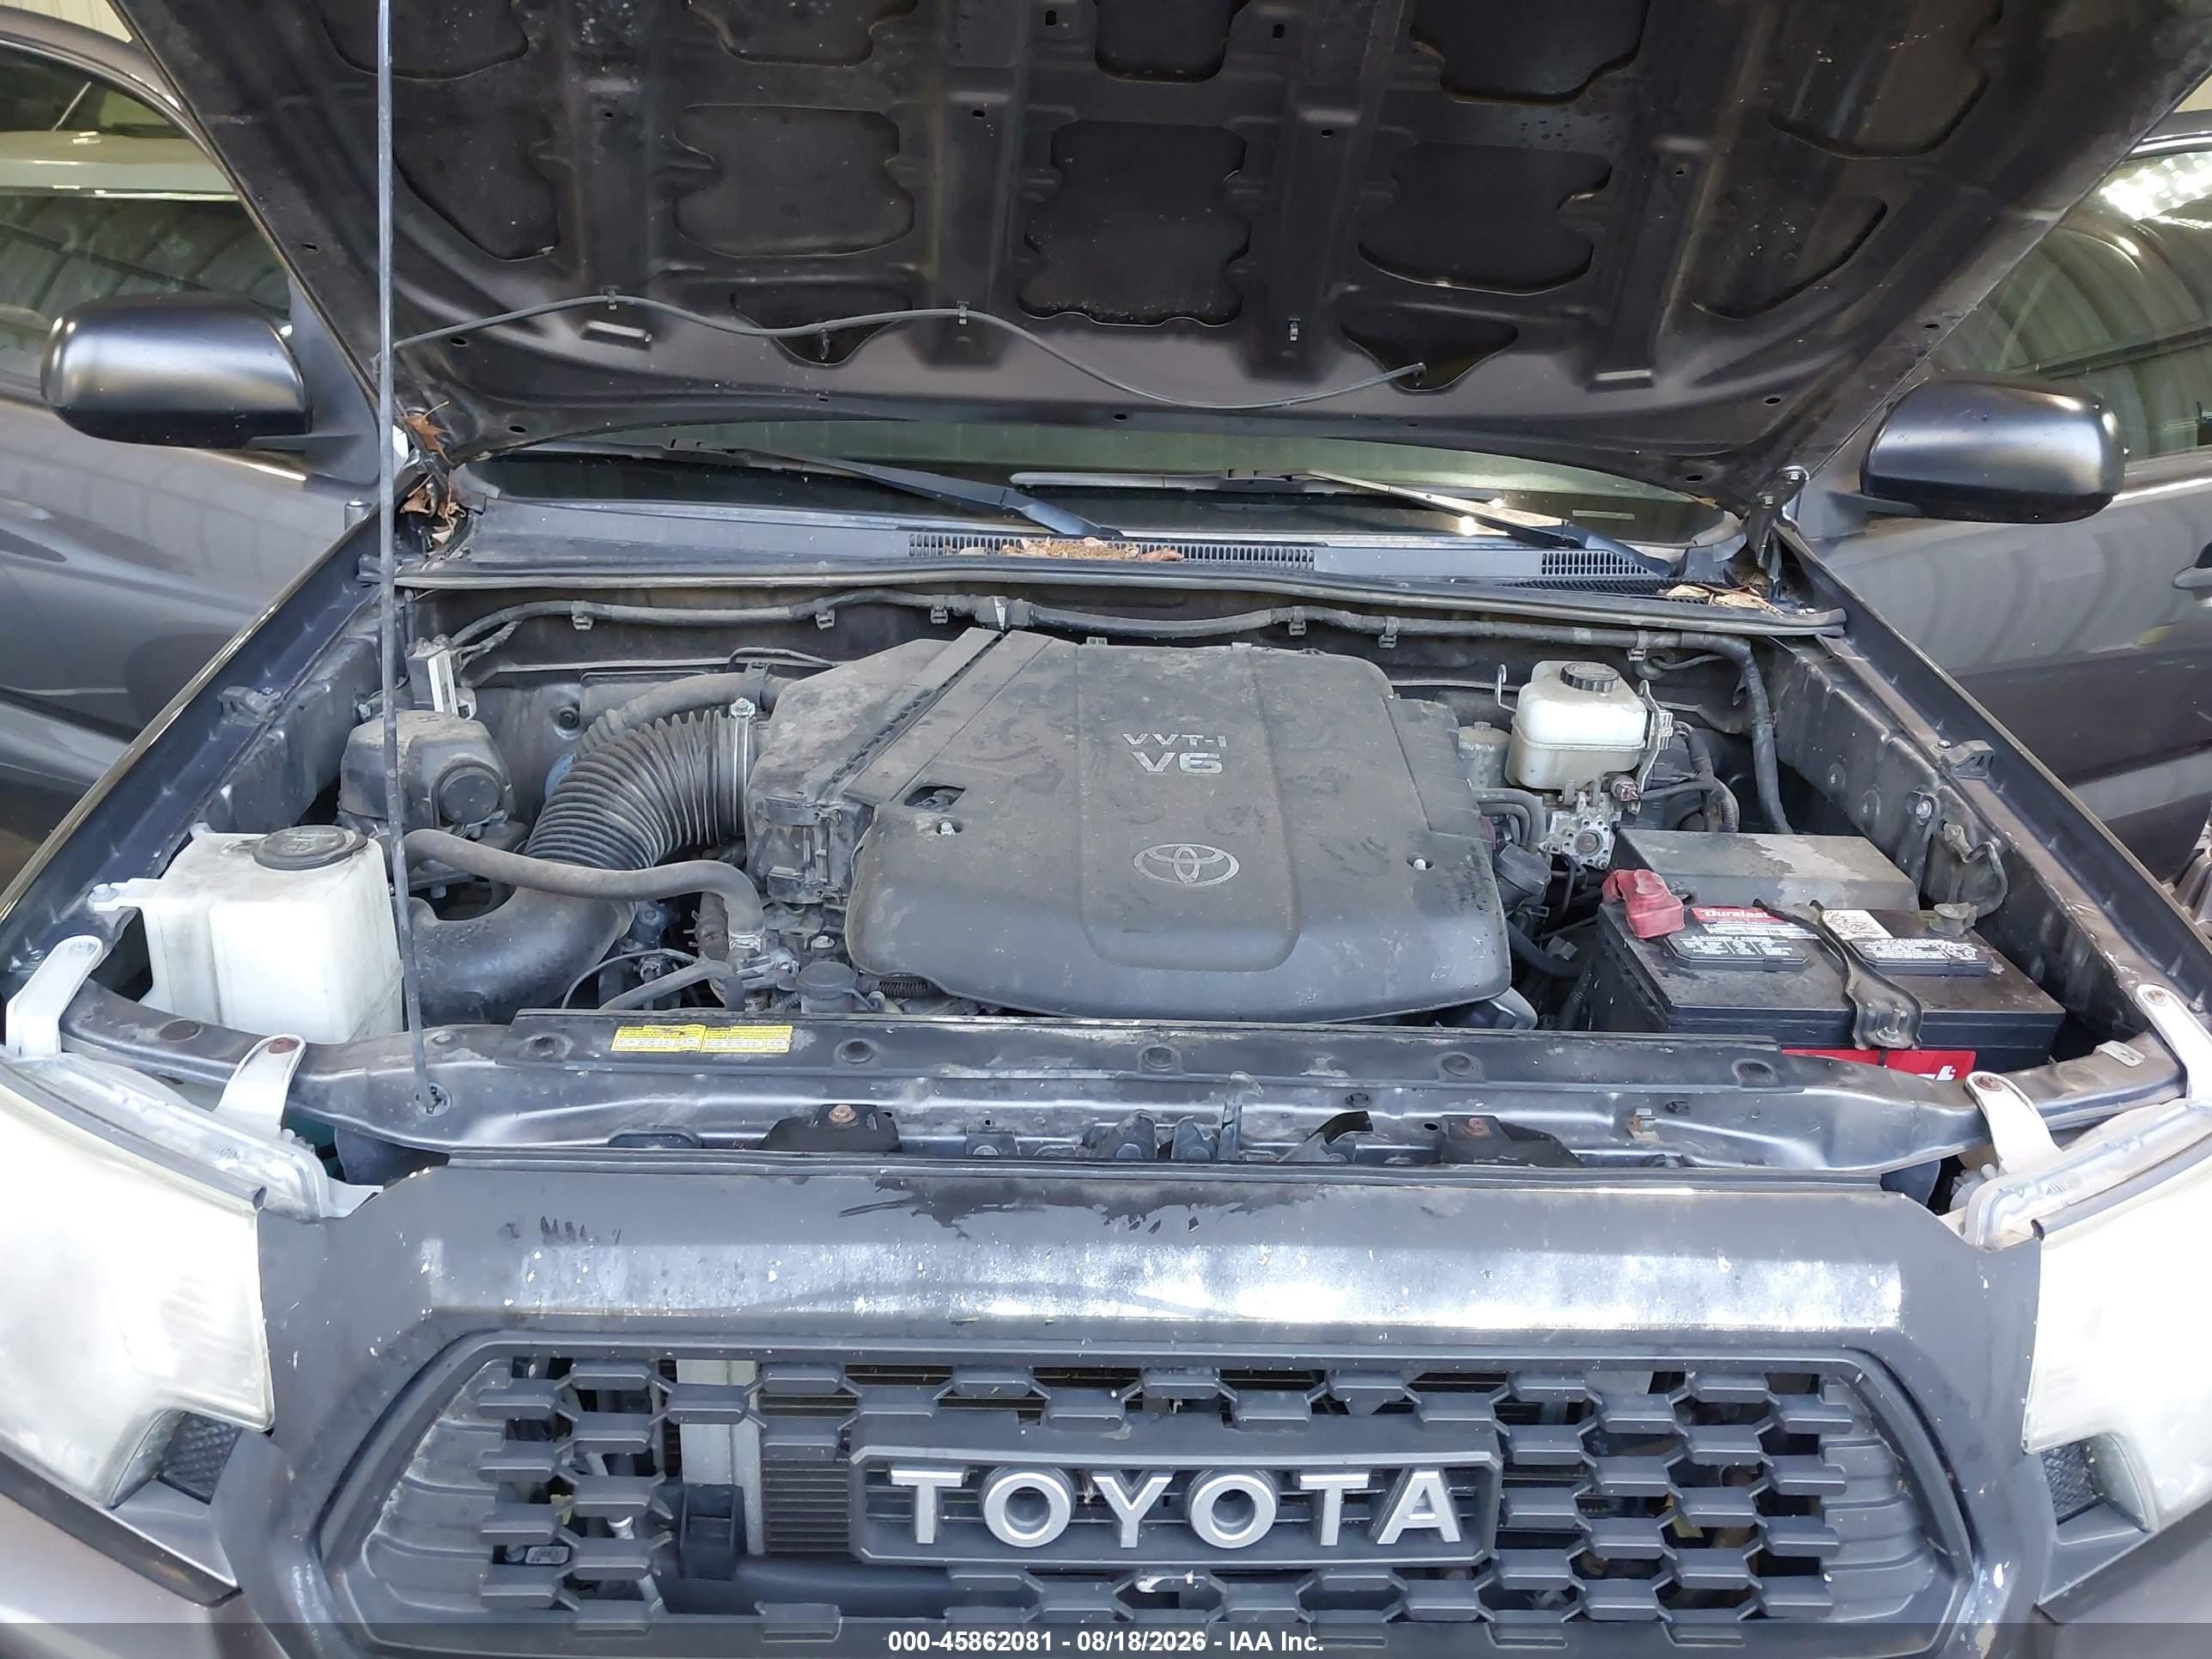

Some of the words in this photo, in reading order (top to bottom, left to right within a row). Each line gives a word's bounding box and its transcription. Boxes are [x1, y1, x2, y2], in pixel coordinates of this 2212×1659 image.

[1131, 751, 1223, 774] V6
[1700, 909, 1771, 919] Duralast
[890, 1466, 1463, 1550] TOYOTA
